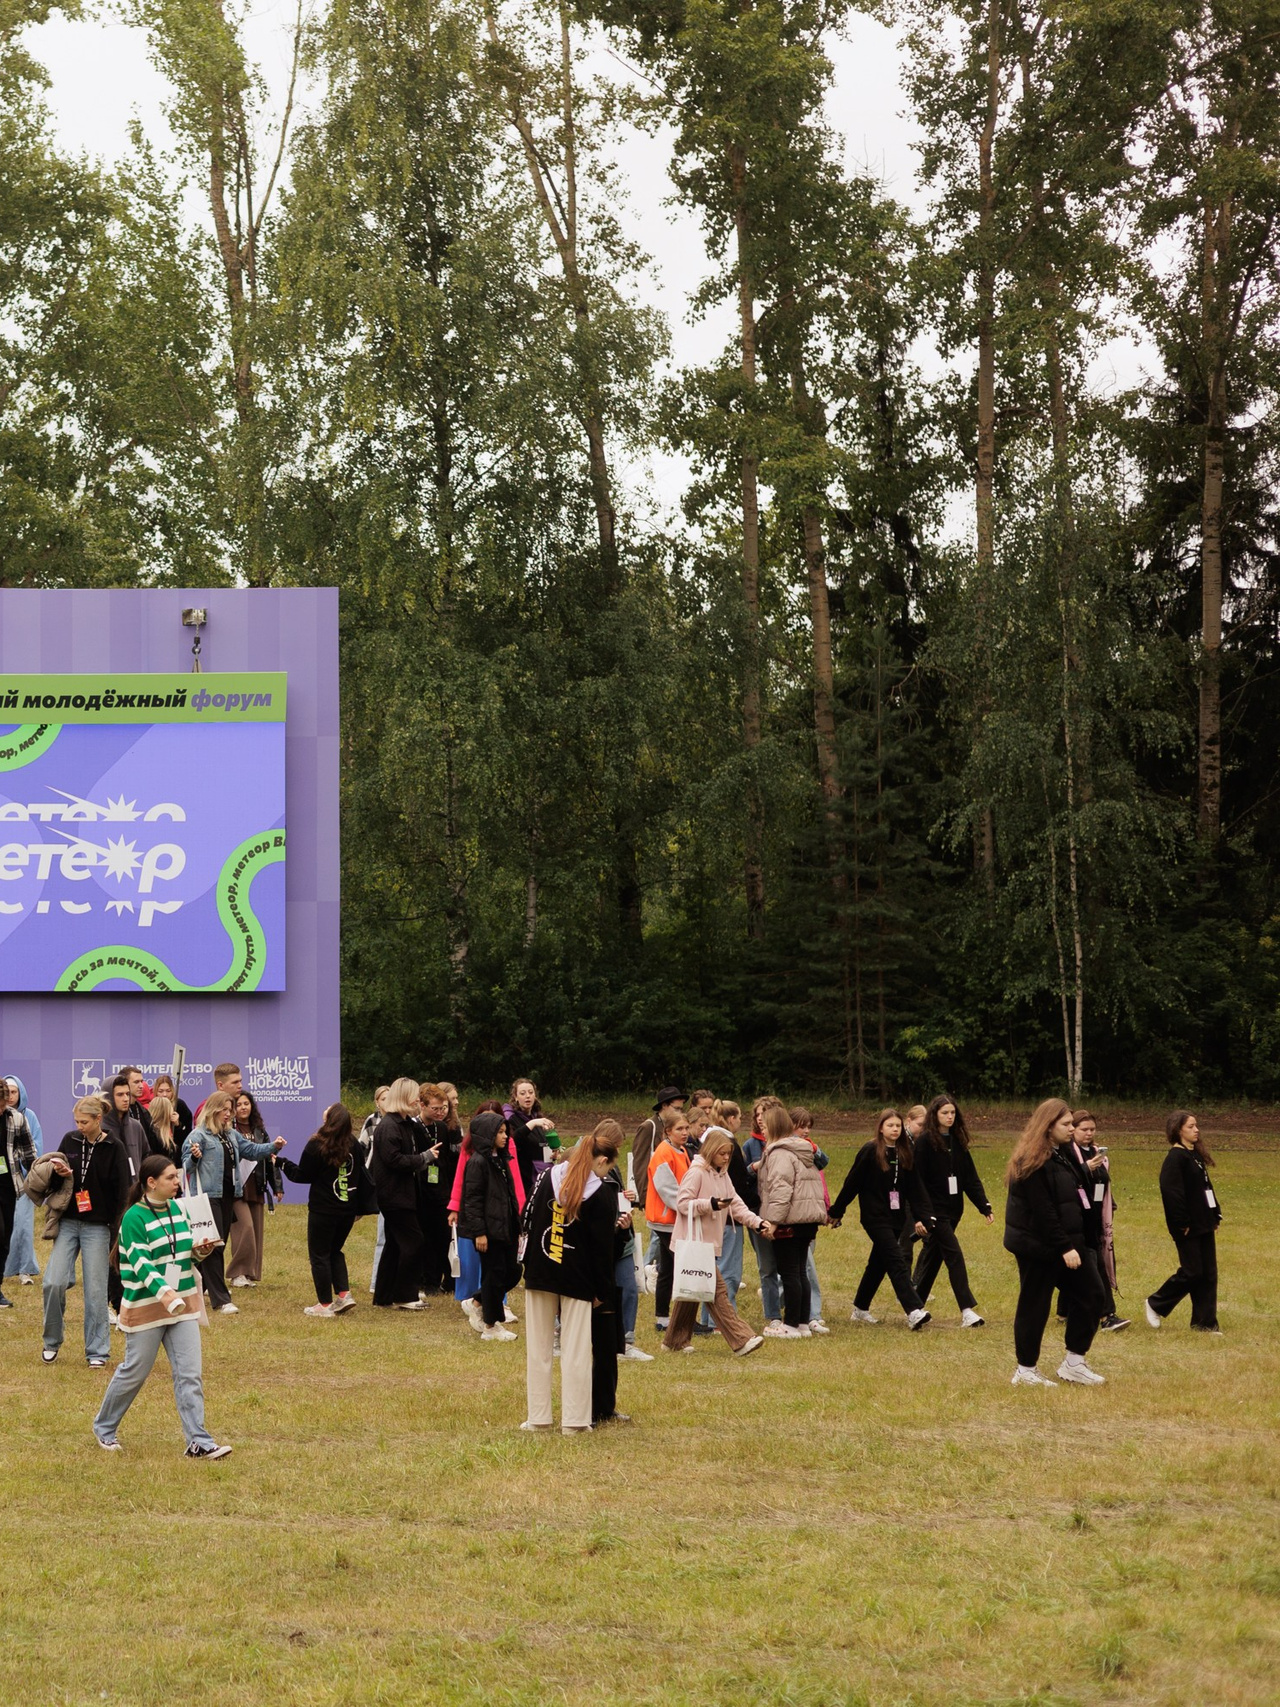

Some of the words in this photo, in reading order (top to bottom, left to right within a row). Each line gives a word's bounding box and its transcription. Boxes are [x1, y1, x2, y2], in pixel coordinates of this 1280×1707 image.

[22, 689, 187, 711] молодёжный
[191, 689, 272, 712] форум
[232, 840, 270, 880] метеор
[228, 882, 249, 933] метеор,
[245, 934, 256, 971] пусть
[90, 959, 104, 971] за
[107, 957, 159, 983] мечтой,
[245, 1056, 309, 1074] НИЖНИЙ
